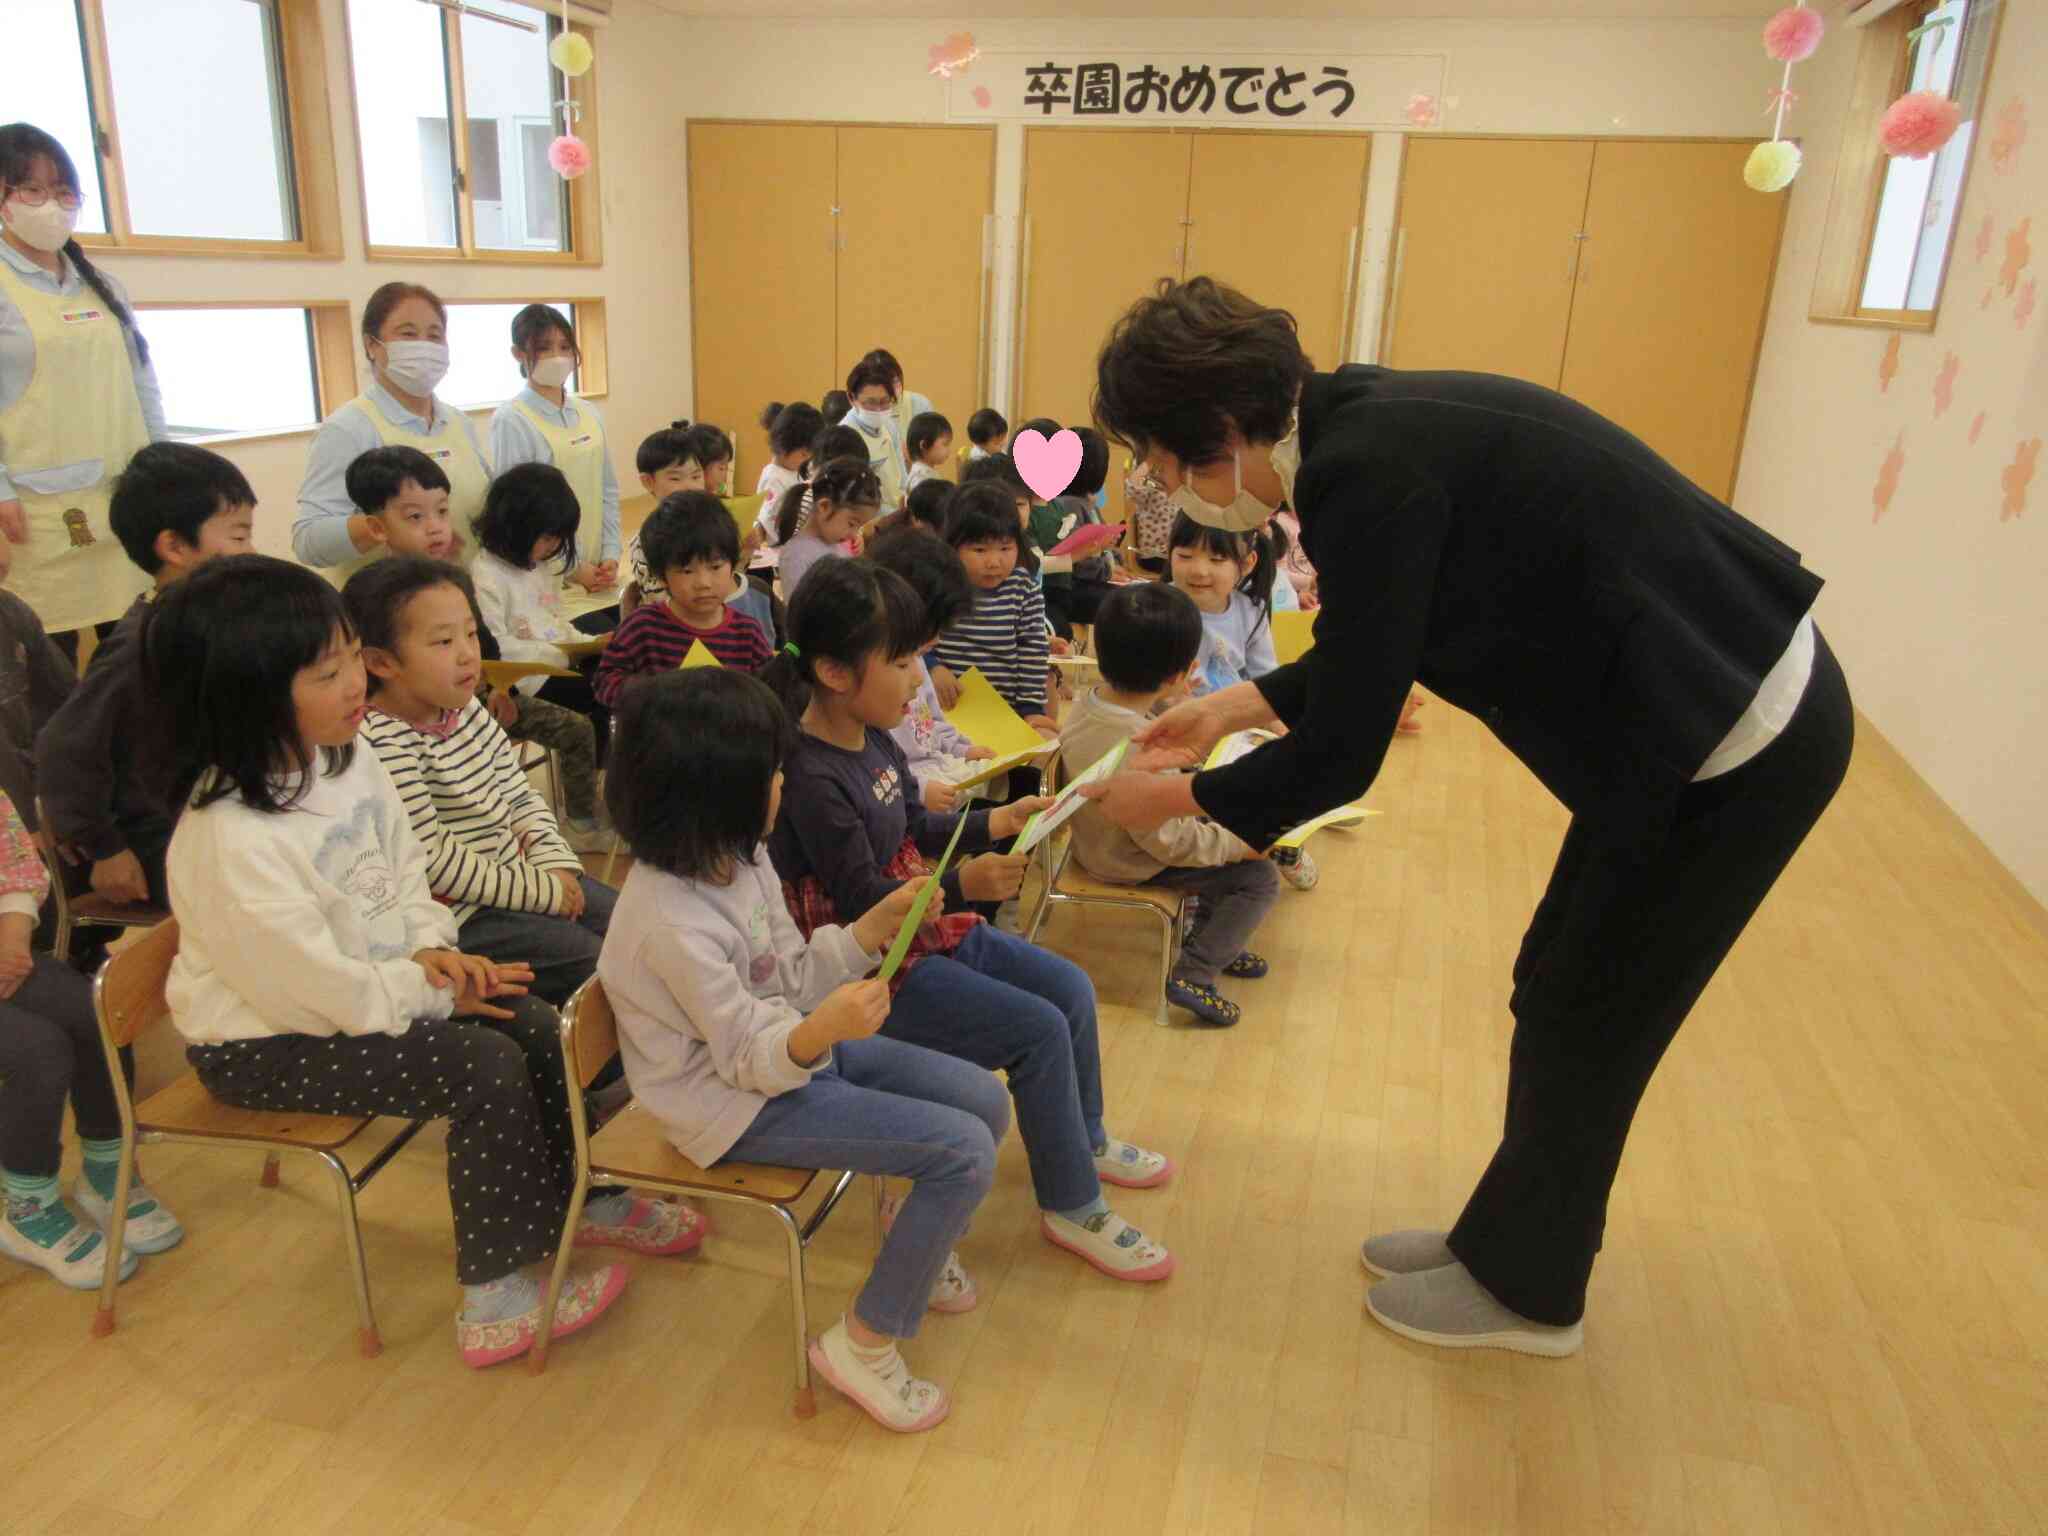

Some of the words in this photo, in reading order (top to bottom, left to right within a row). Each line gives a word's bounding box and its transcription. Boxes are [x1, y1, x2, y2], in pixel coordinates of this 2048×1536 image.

[1024, 62, 1355, 117] 卒園おめでとう
